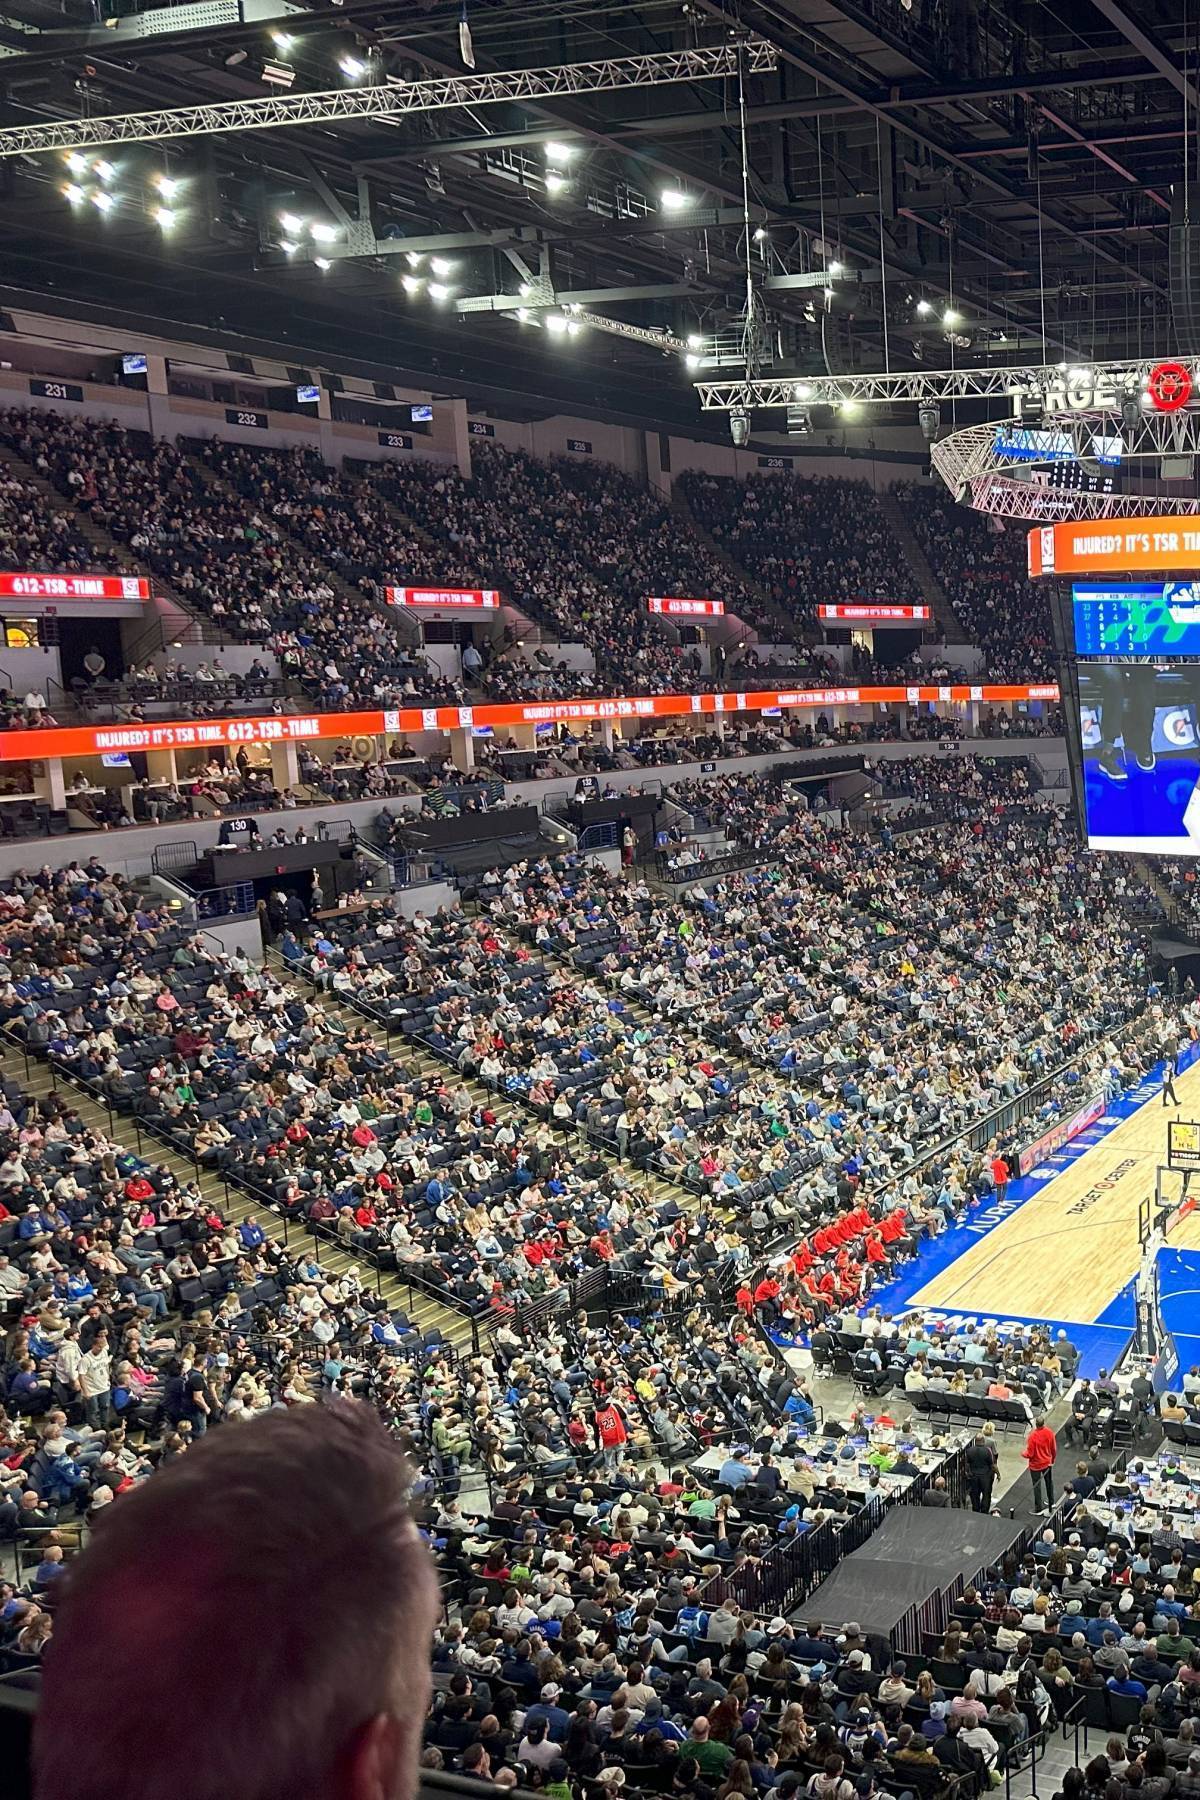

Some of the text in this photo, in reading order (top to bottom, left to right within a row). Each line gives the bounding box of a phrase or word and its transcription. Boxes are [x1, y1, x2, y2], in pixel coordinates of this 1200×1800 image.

[45, 384, 67, 399] 231
[237, 412, 257, 427] 232
[473, 424, 487, 434] 234
[387, 435, 403, 448] 233
[767, 458, 784, 467] 236
[1073, 534, 1121, 555] INJURED?
[1125, 533, 1150, 554] IT'S
[1153, 532, 1178, 552] TSR
[12, 577, 105, 595] 612-TSR-TIME
[1098, 603, 1104, 611] 4
[1112, 603, 1118, 611] 2
[1126, 603, 1132, 611] 1
[1141, 603, 1146, 611] 0
[1099, 613, 1104, 621] 5
[1113, 613, 1118, 621] 4
[1128, 623, 1133, 631] 4
[1128, 633, 1132, 641] 1
[1028, 688, 1058, 697] INJURED?
[523, 708, 554, 720] INJURED?
[599, 700, 655, 716] 612-TSR-TIME
[96, 719, 320, 748] INJURED? IT'S TSR TIME. 612-TSR-TIME
[229, 820, 247, 831] 130
[1066, 1158, 1140, 1216] TARGET CENTER
[601, 1416, 617, 1432] 23
[679, 1626, 689, 1635] 5
